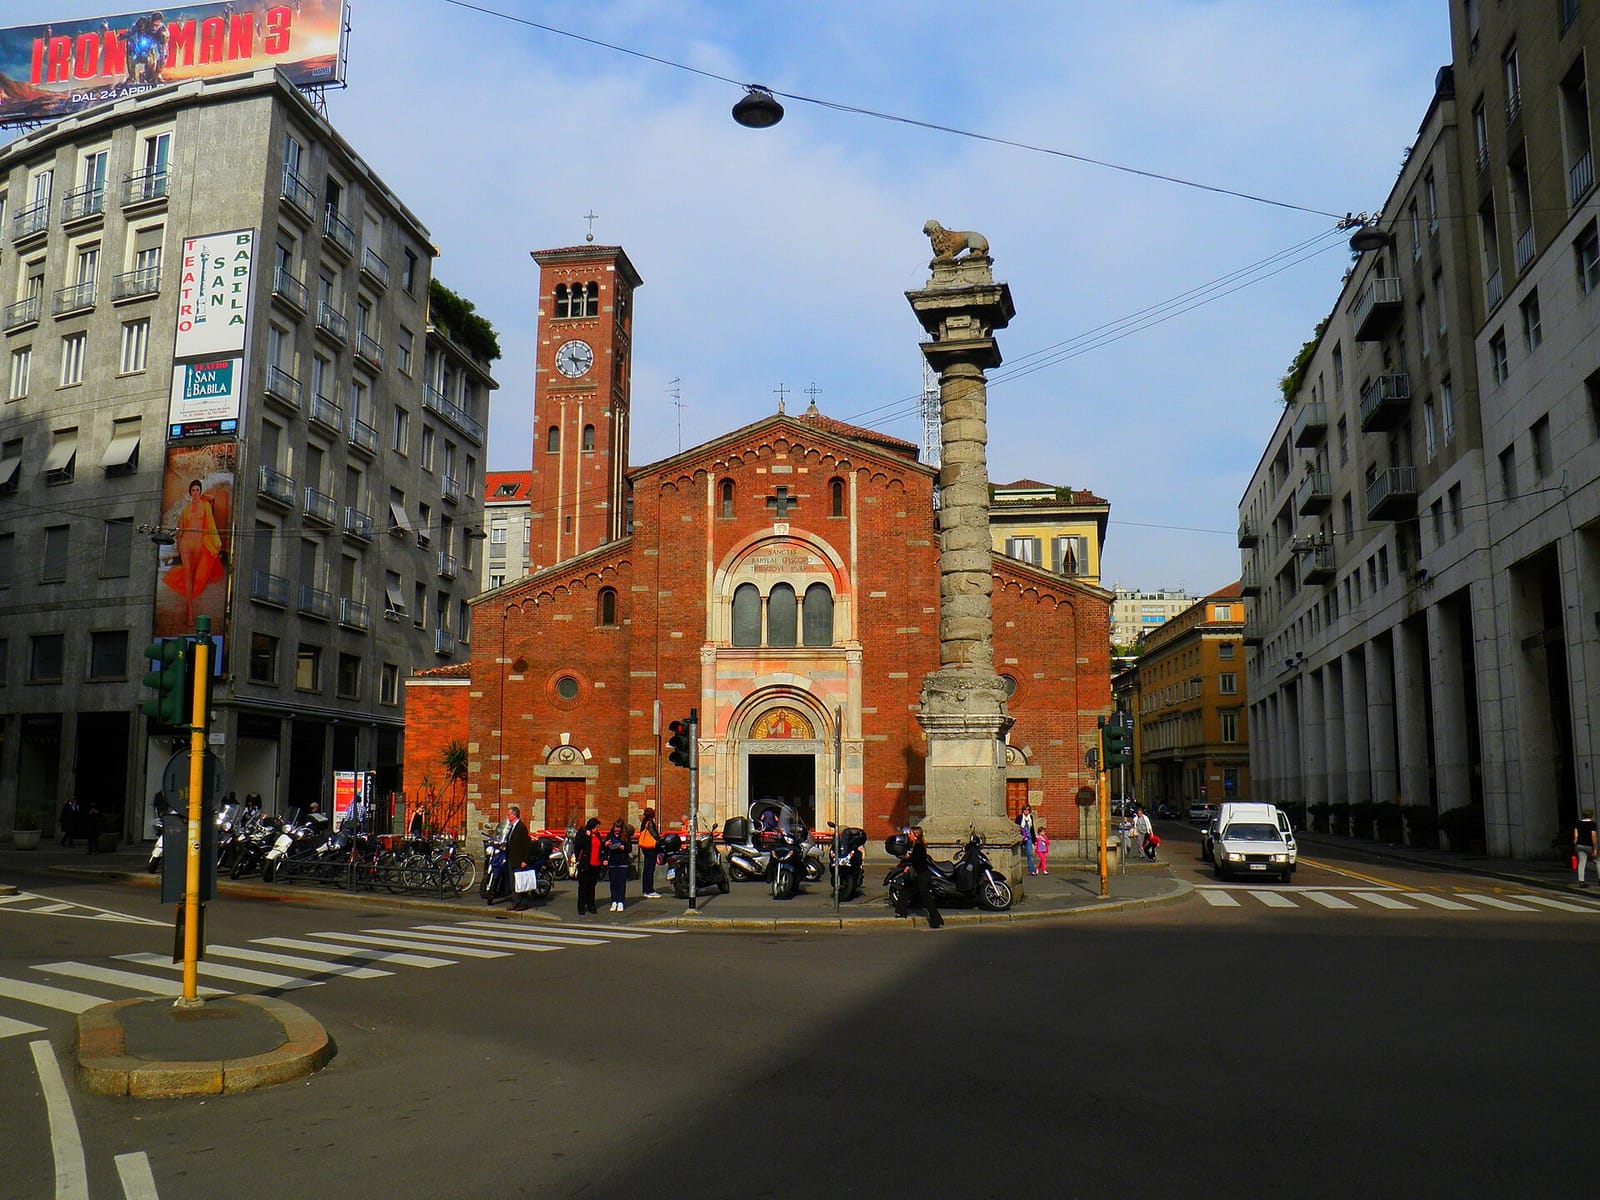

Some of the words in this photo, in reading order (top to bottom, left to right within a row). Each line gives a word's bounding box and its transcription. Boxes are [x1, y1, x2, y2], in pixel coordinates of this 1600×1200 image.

[30, 29, 127, 86] IRON
[167, 12, 254, 69] MAN
[265, 5, 292, 55] 3
[72, 93, 97, 103] DAL
[100, 90, 118, 100] 24
[179, 239, 197, 332] TEATRO
[211, 256, 226, 307] SAN
[228, 234, 251, 326] BABILA
[193, 383, 227, 396] BABILA
[194, 370, 216, 384] SAN
